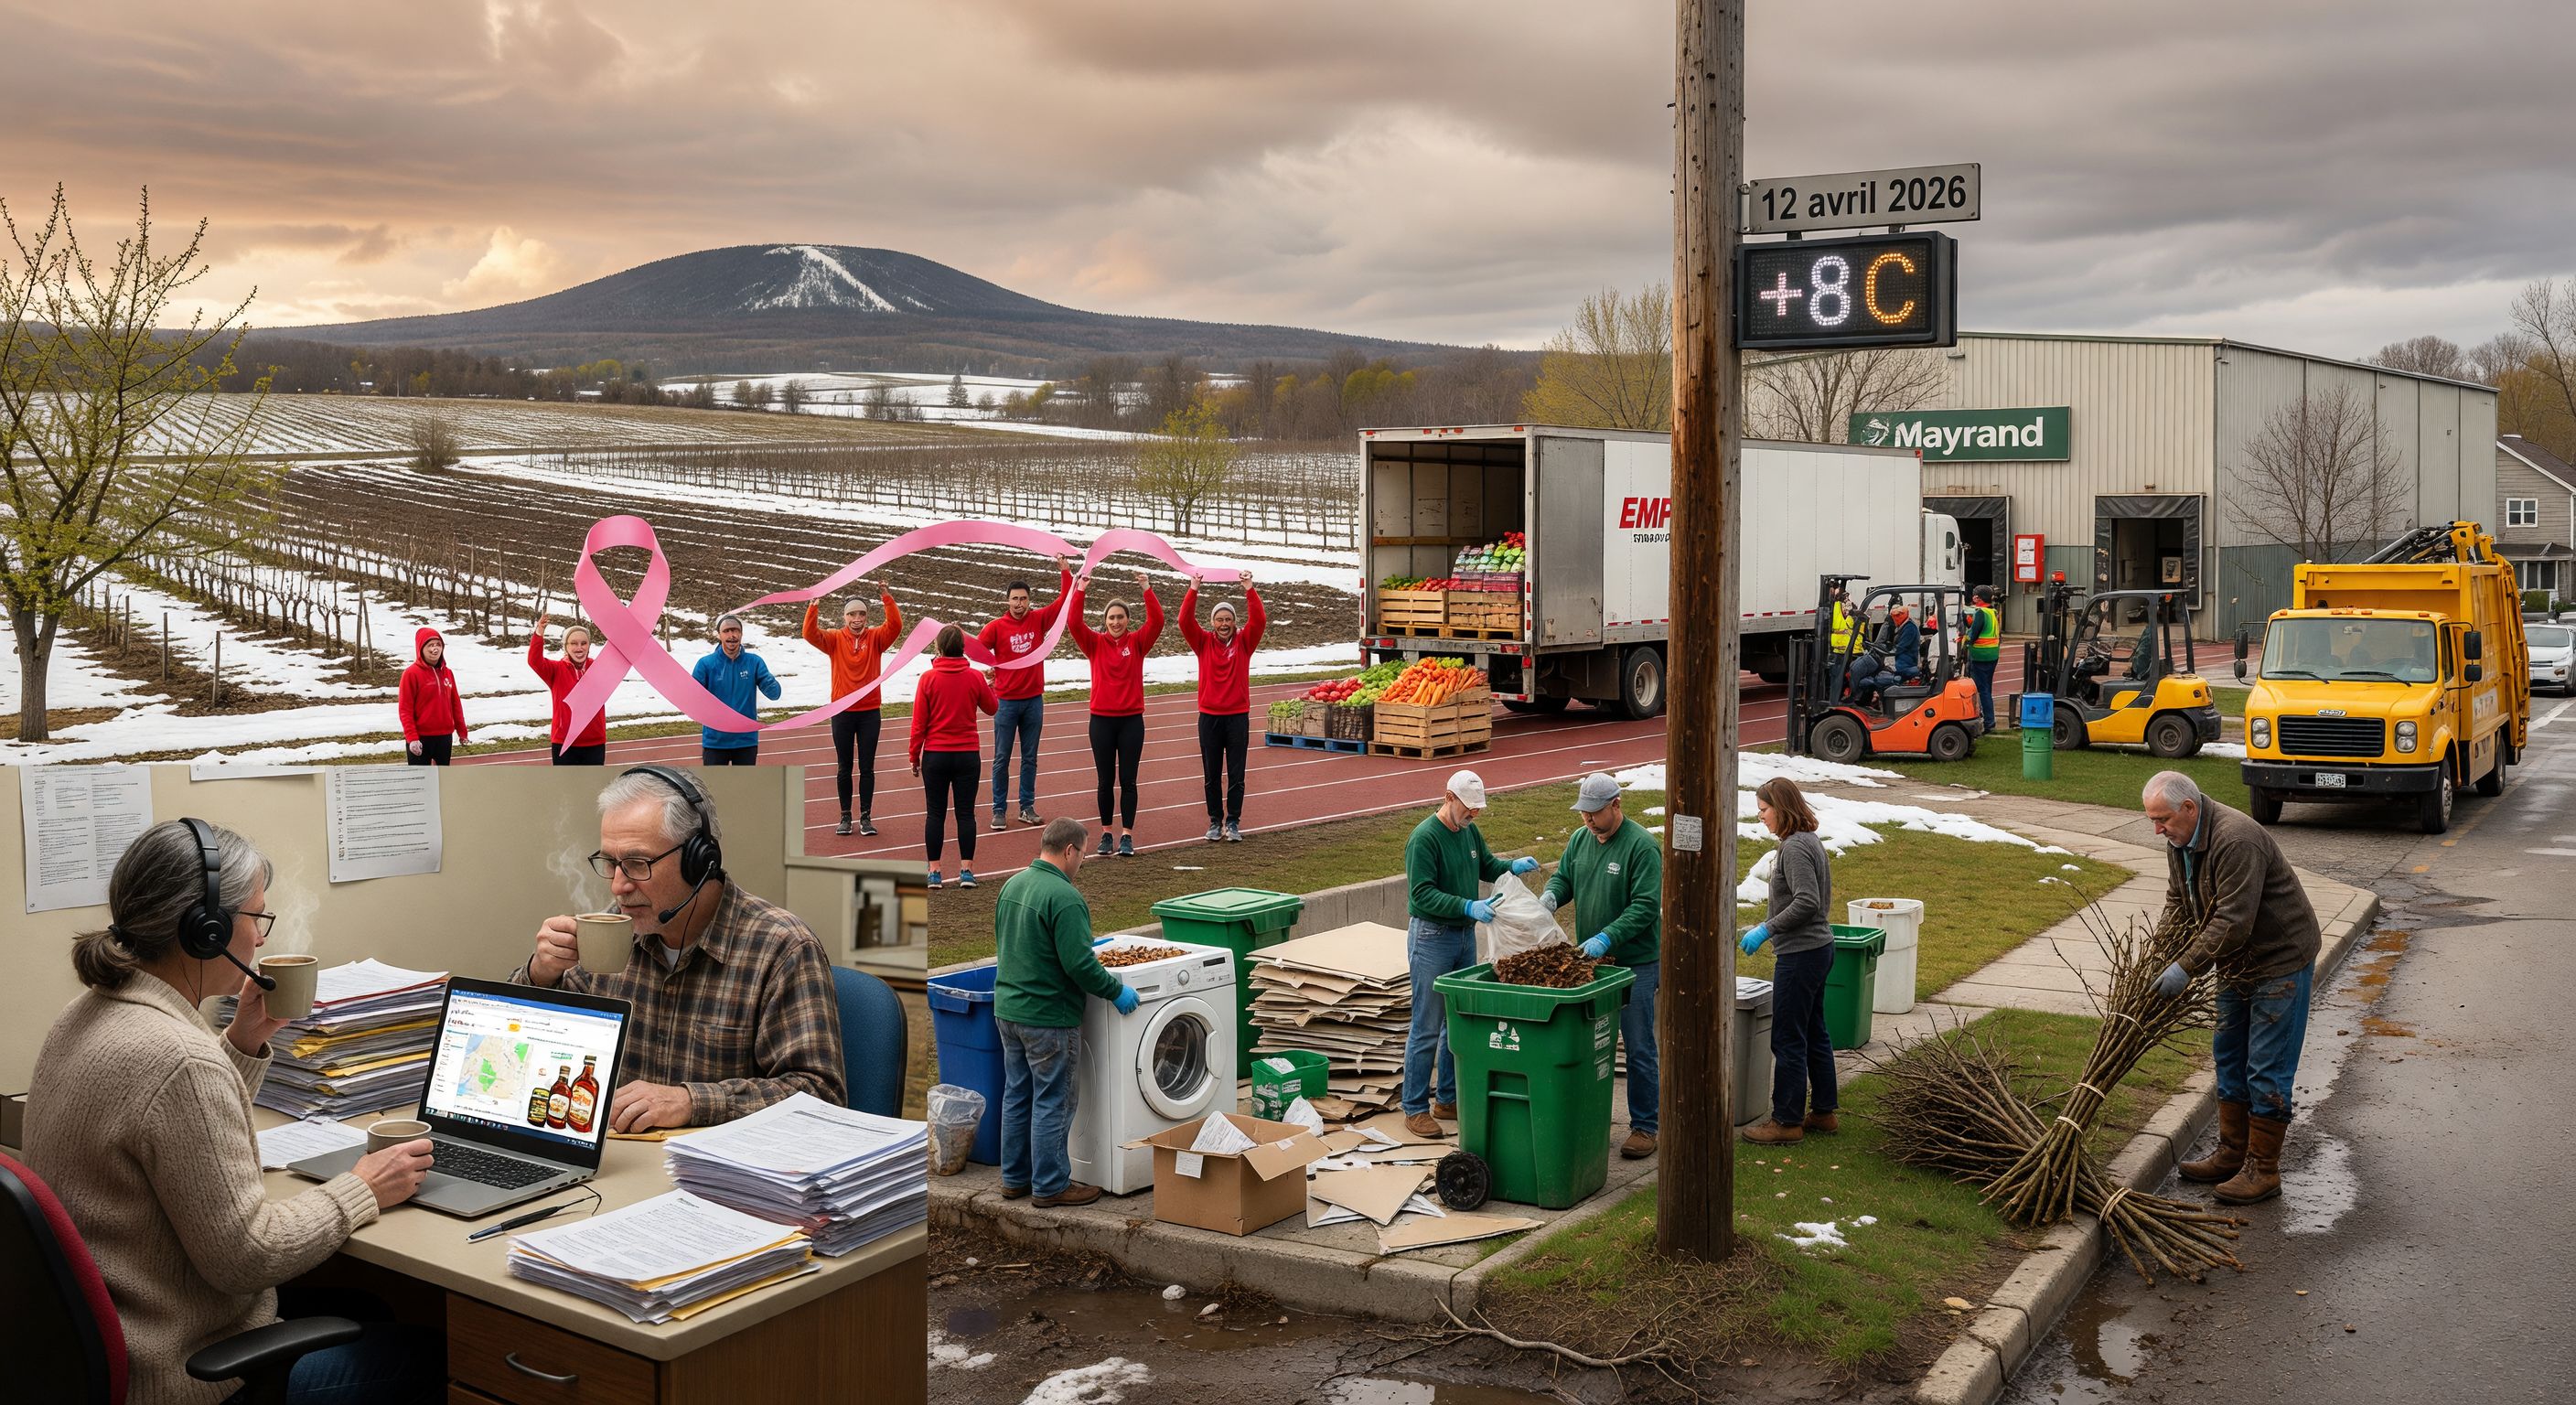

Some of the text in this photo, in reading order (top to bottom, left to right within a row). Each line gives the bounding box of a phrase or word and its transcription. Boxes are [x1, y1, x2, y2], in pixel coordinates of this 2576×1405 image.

[1762, 175, 1967, 221] 12 avril 2026
[1865, 252, 1916, 325] C
[1894, 416, 2044, 456] Mayrand
